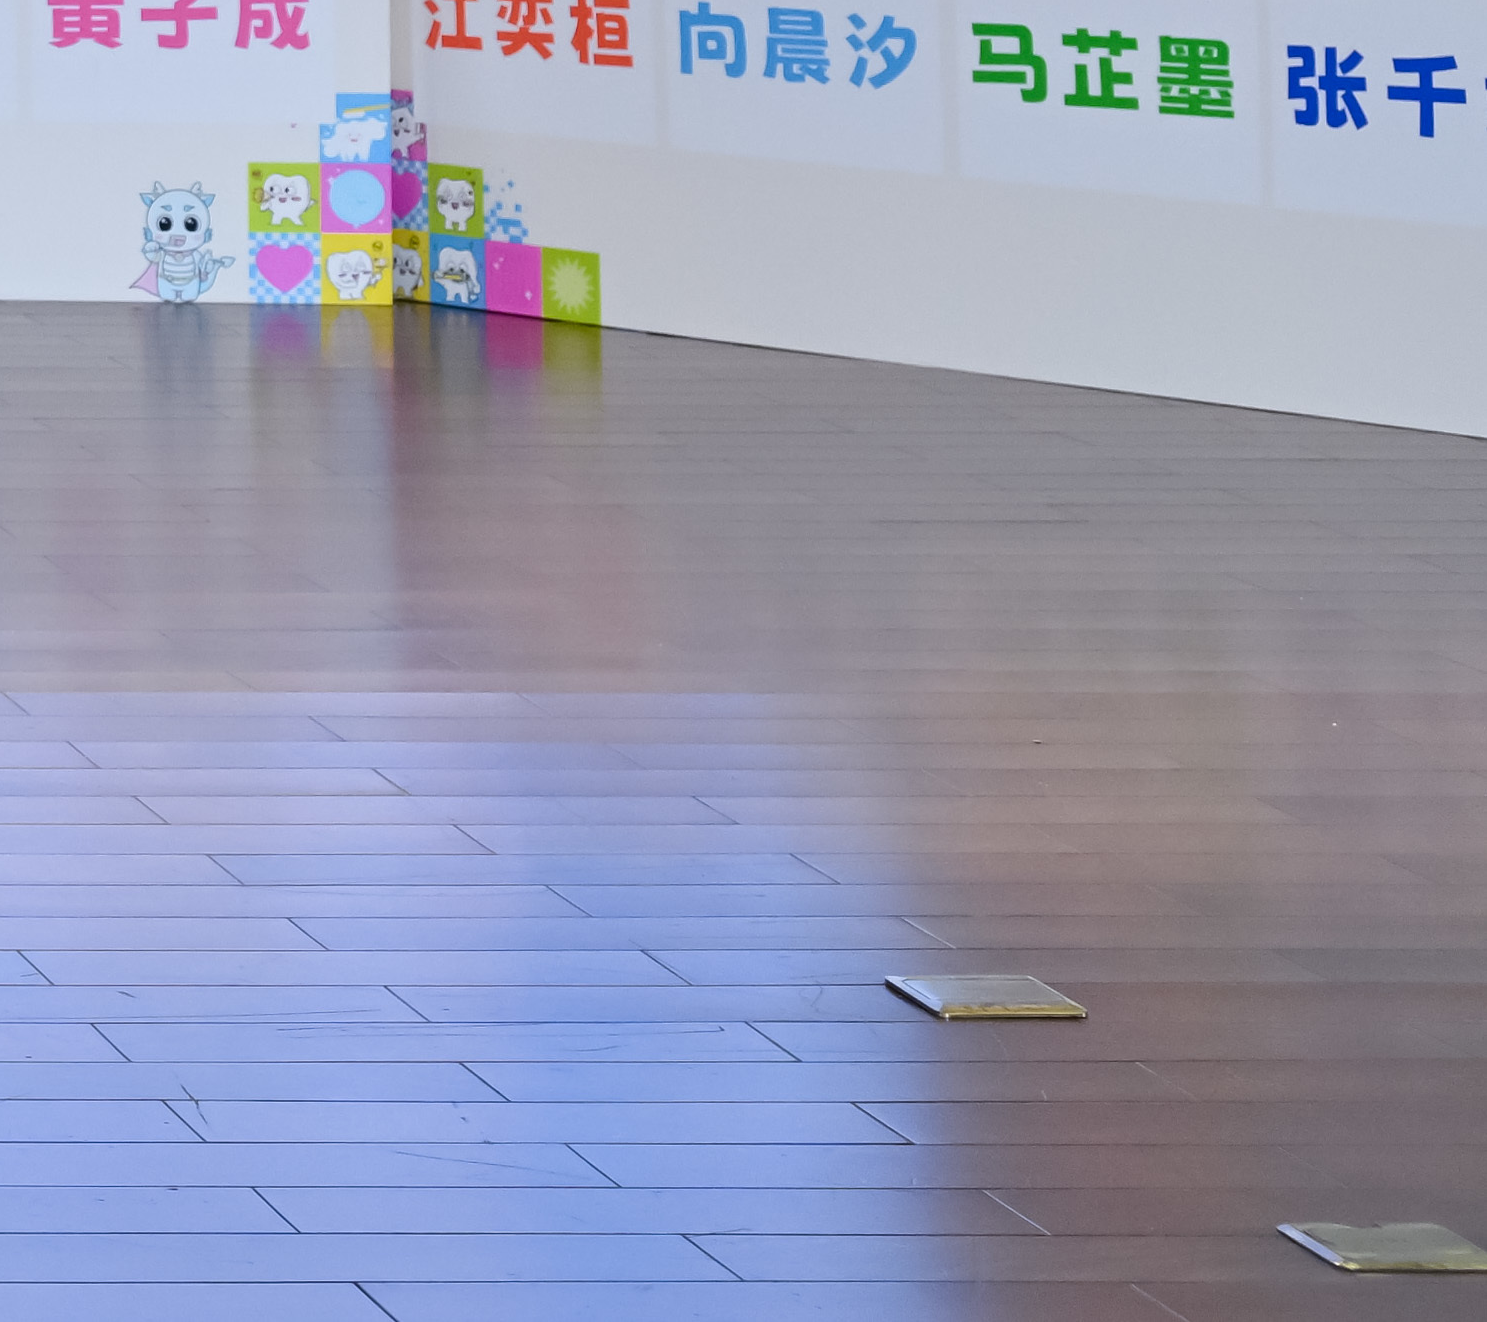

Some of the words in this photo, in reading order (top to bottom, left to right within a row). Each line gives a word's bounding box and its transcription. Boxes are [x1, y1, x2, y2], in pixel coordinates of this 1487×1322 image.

[679, 1, 918, 90] 向晨汐
[972, 22, 1237, 120] 马芷墨
[1287, 45, 1487, 138] 张千
